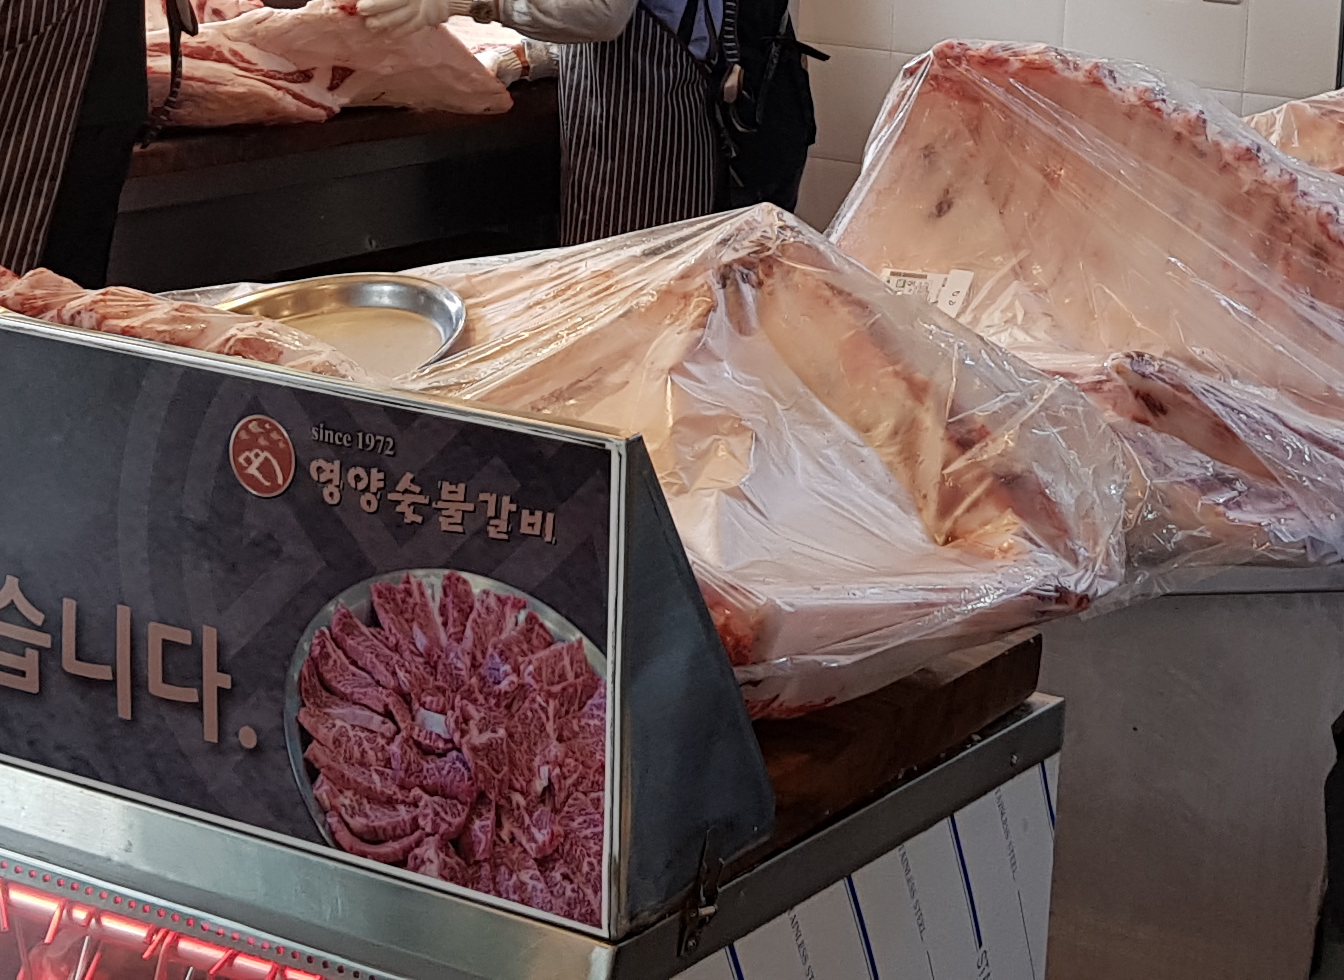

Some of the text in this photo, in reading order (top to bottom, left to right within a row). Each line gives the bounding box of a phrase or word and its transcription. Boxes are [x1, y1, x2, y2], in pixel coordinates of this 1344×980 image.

[311, 423, 396, 456] since 1972
[309, 458, 556, 544] 영양숯불갈비
